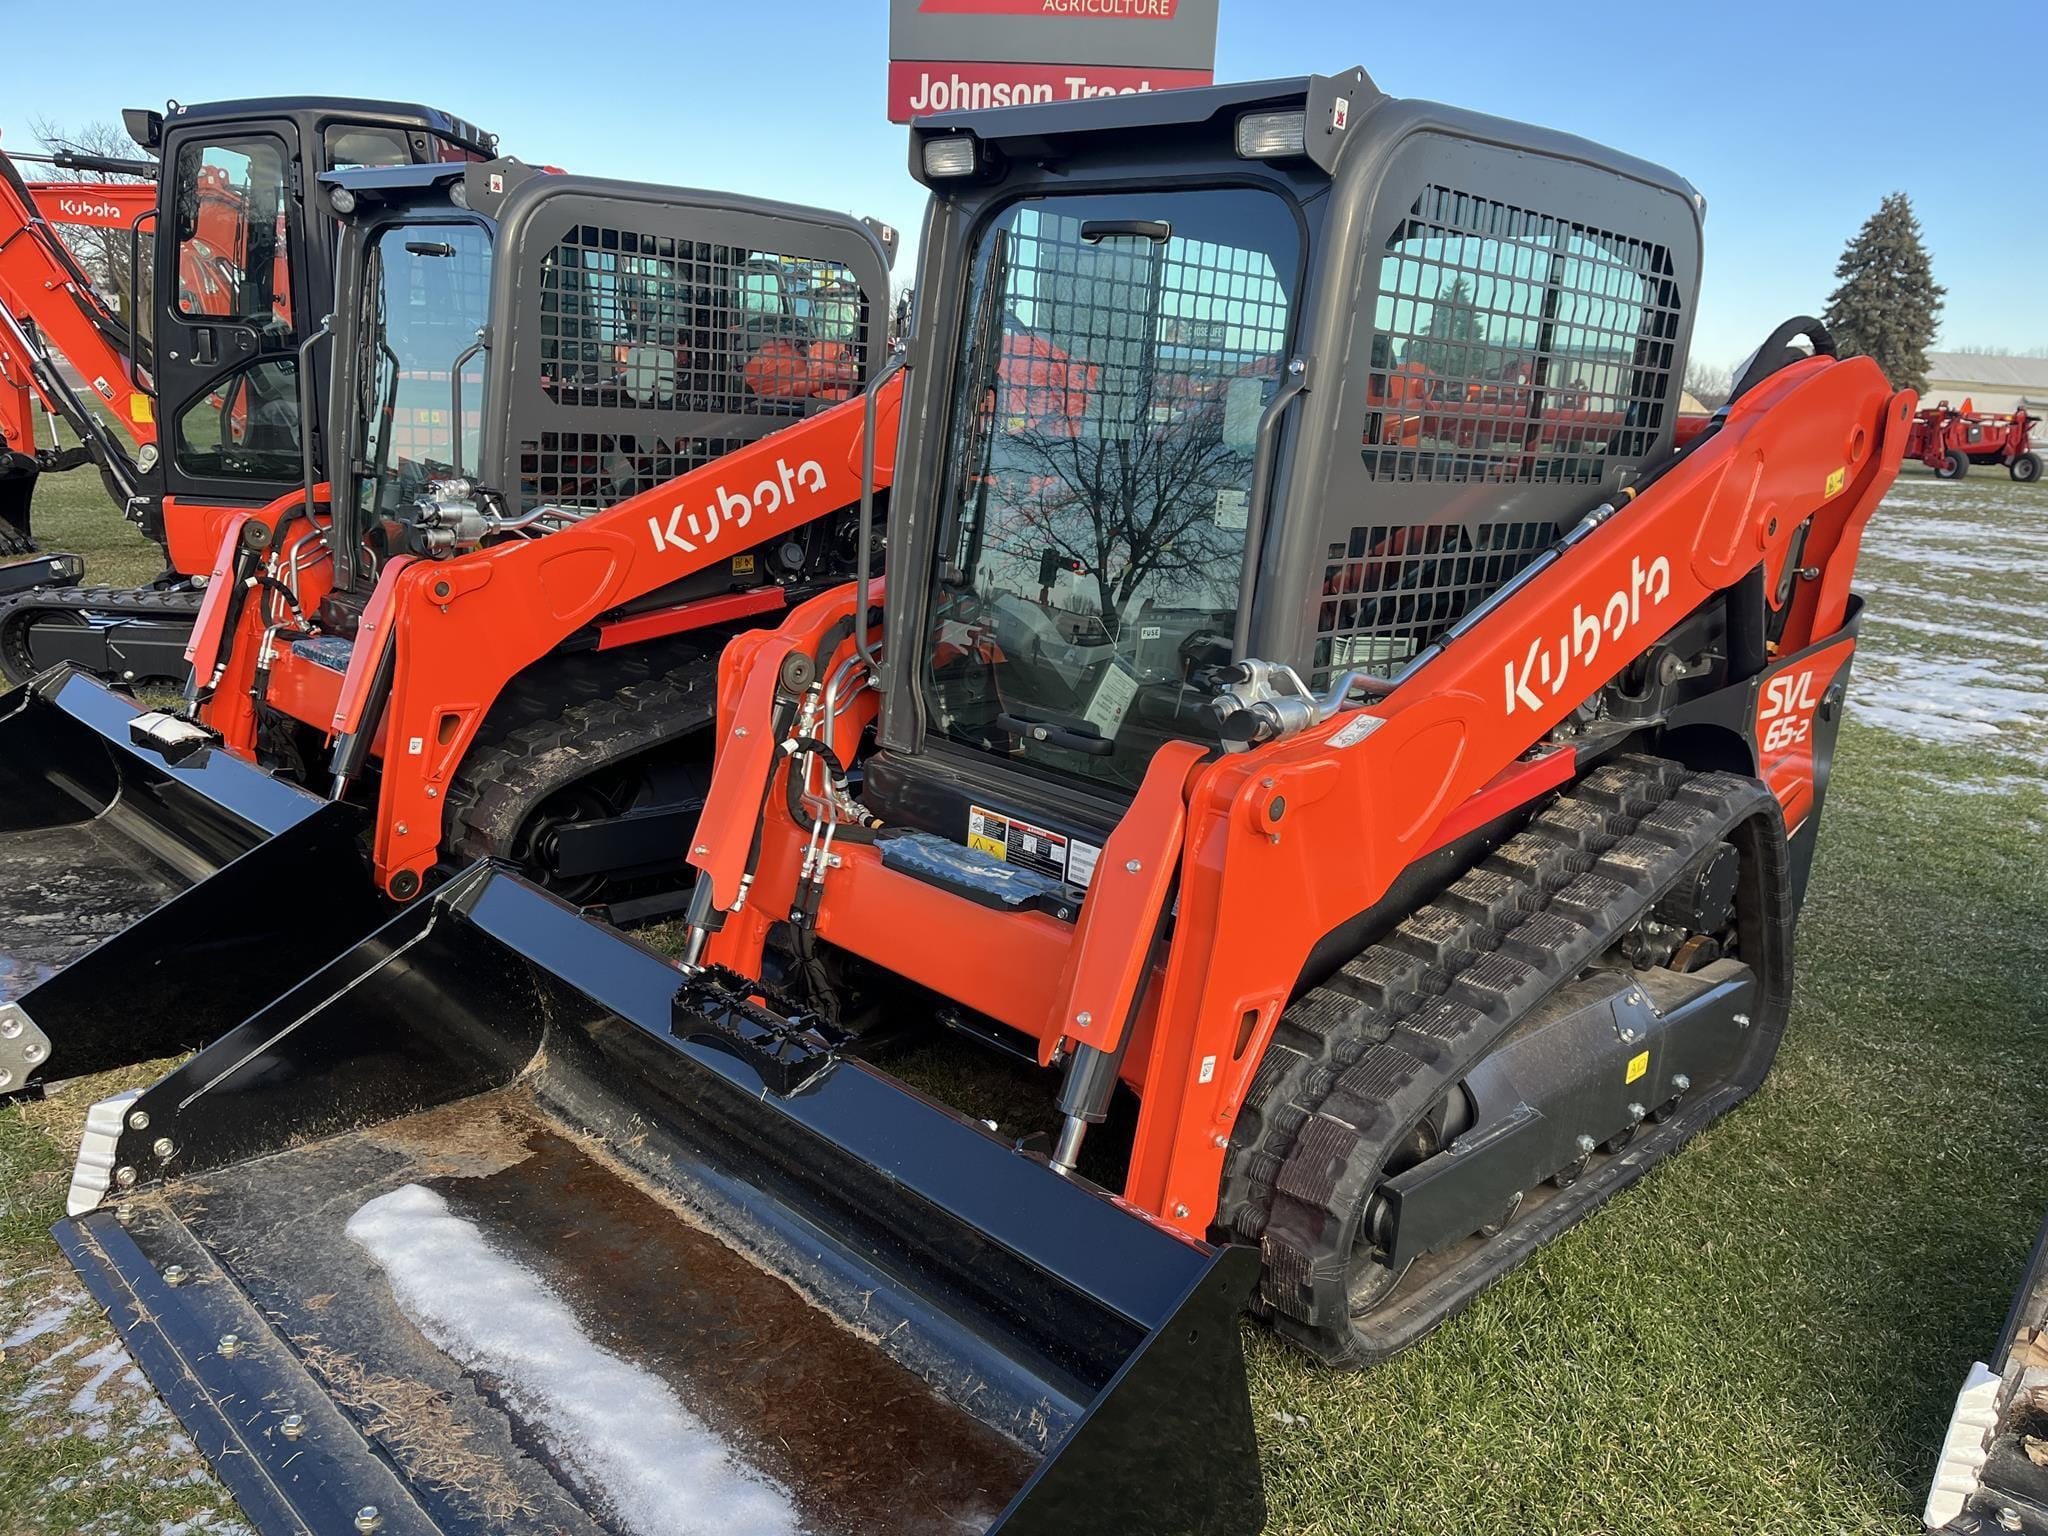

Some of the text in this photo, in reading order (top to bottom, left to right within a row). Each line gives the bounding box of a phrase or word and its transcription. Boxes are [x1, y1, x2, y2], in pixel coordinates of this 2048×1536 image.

[1042, 0, 1169, 15] AGRICULTURE
[910, 73, 1052, 111] Johnson
[60, 199, 120, 218] Kubota
[648, 458, 827, 553] Kubota
[1142, 628, 1160, 637] FUSE
[1504, 555, 1669, 716] Kubota
[1760, 671, 1816, 719] SVL
[1763, 715, 1809, 752] 65-2
